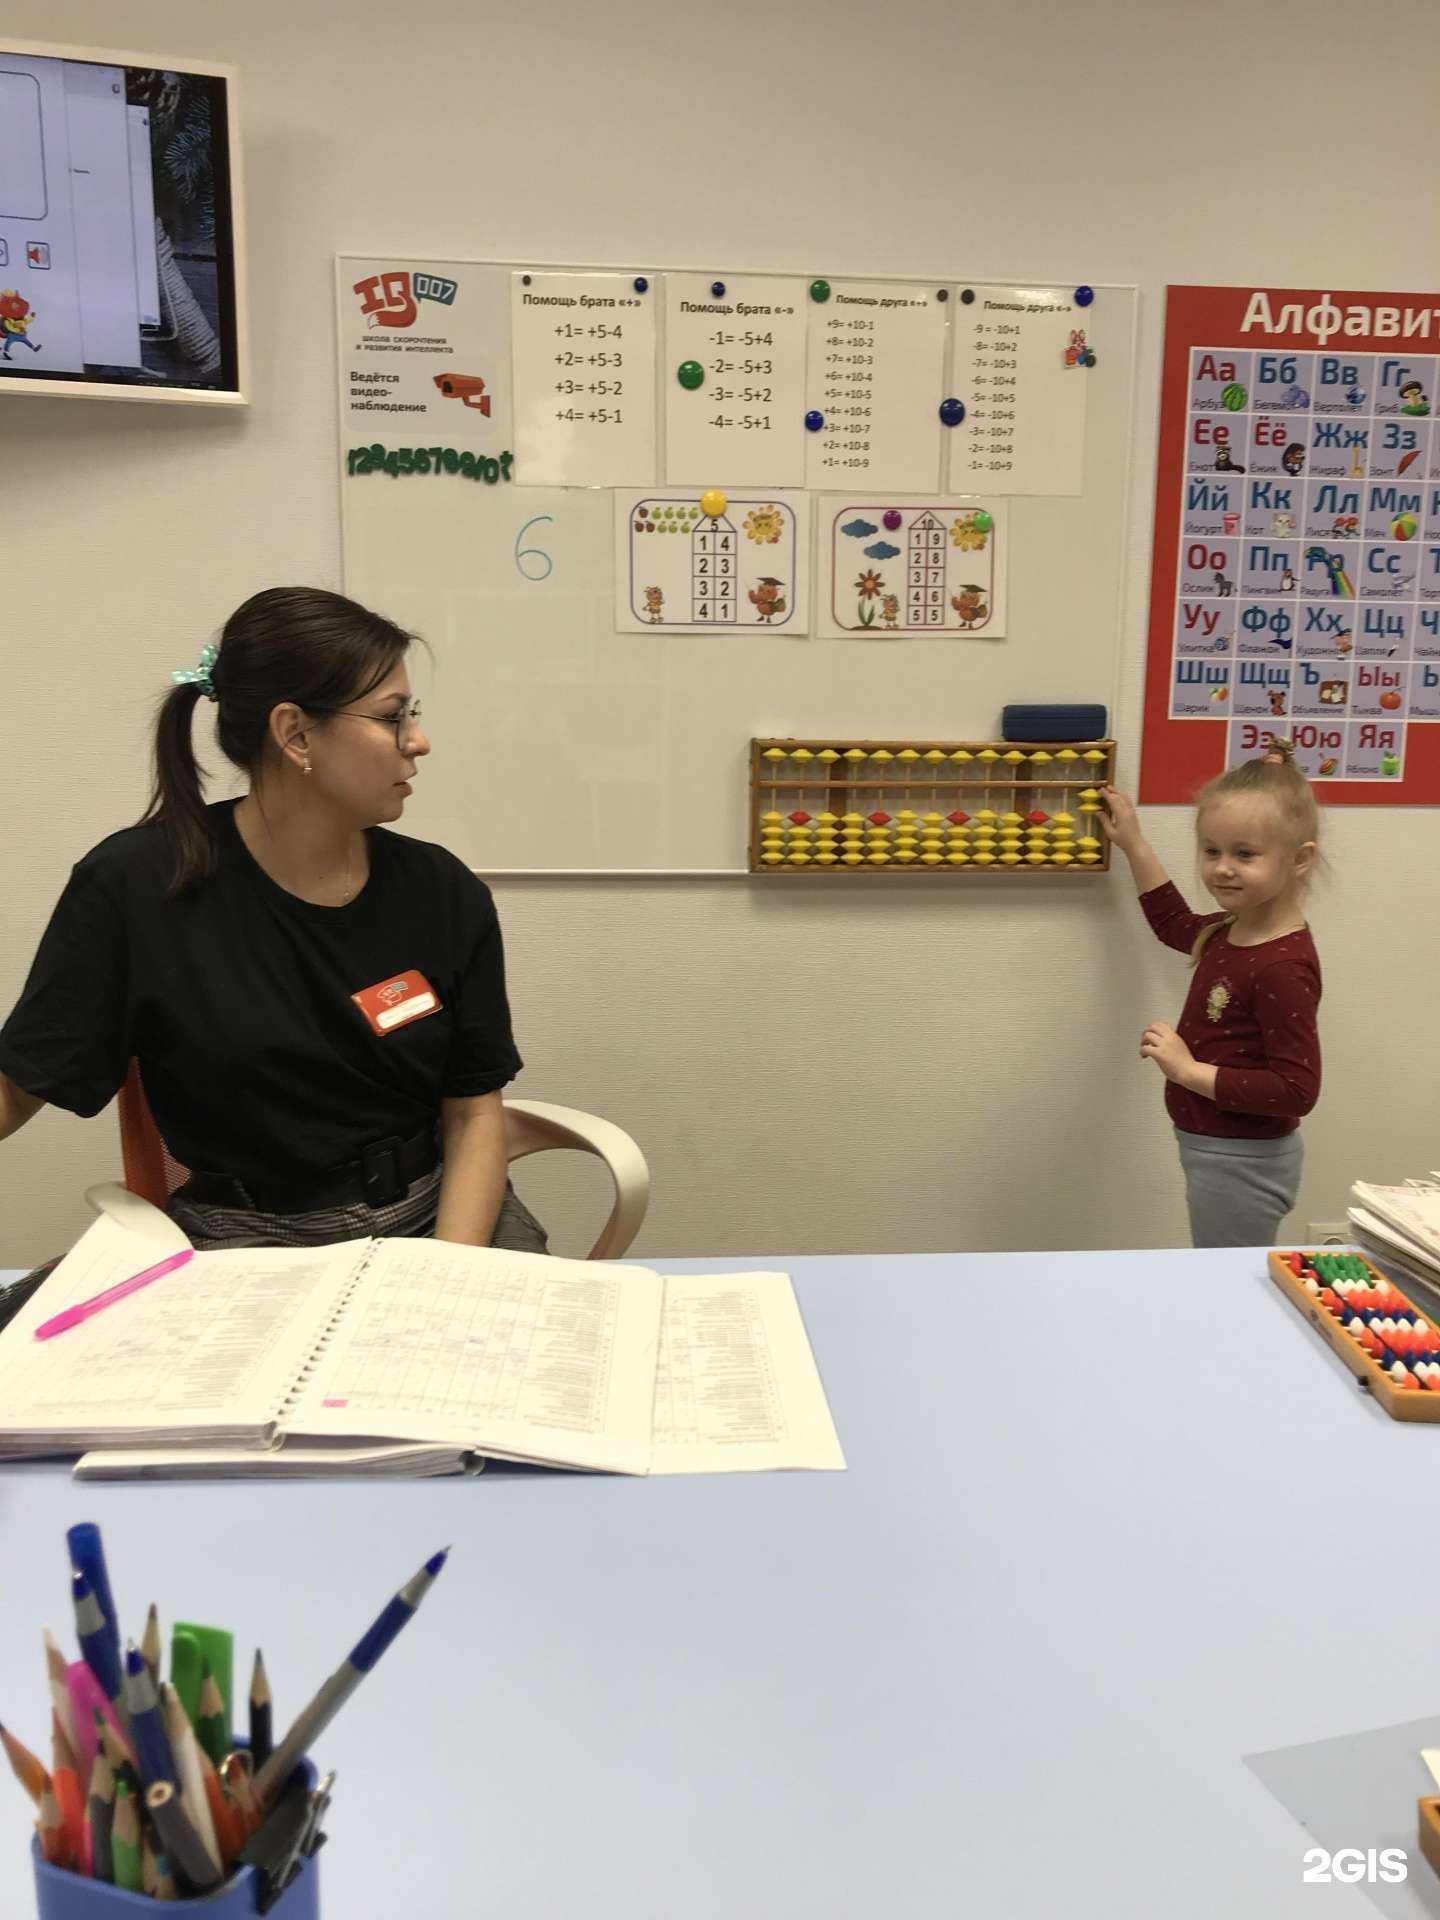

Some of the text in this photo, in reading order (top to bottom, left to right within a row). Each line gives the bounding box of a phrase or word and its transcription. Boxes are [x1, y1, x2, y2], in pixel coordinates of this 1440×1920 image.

[417, 277, 454, 299] 007
[523, 294, 577, 307] Помощь
[580, 295, 615, 308] брата
[680, 301, 734, 315] Помощь
[736, 303, 771, 316] брата
[836, 295, 879, 307] Помощь
[879, 298, 908, 308] друга
[984, 301, 1025, 312] Помощь
[1026, 303, 1054, 313] друга
[554, 324, 622, 338] +1= +5-4
[709, 331, 773, 346] -1= -5+4
[554, 352, 622, 367] +2= +5-3
[709, 359, 772, 374] -2= -5+3
[1196, 355, 1235, 381] Аа
[1259, 357, 1297, 384] Бб
[1320, 358, 1358, 385] Вв
[1382, 361, 1410, 387] Гг
[350, 371, 400, 383] Ведётся
[350, 387, 392, 397] видео-
[555, 380, 622, 395] +3= +5-2
[709, 387, 772, 402] -3= -5+2
[350, 401, 427, 412] наблюдение
[556, 408, 623, 423] +4= +5-1
[709, 415, 771, 430] -4= -5+1
[1194, 419, 1229, 445] Ее
[1255, 416, 1287, 446] Ёё
[1312, 422, 1368, 448] Жж
[1382, 423, 1416, 449] Зз
[1188, 478, 1228, 511] Йй
[1252, 481, 1292, 509] Кк
[1313, 485, 1360, 513] Лл
[1369, 487, 1421, 512] Мм
[710, 518, 719, 532] 5
[699, 535, 707, 551] 1
[720, 536, 730, 551] 4
[914, 533, 921, 545] 1
[932, 533, 940, 545] 9
[514, 516, 554, 582] 6
[914, 552, 921, 564] 2
[932, 552, 940, 564] 8
[1188, 544, 1227, 570] Оо
[1249, 546, 1289, 571] Пп
[1368, 548, 1401, 573] Сс
[699, 558, 708, 573] 2
[721, 558, 730, 574] 3
[914, 571, 921, 583] 3
[932, 571, 939, 583] 7
[699, 580, 708, 596] 3
[720, 581, 730, 596] 2
[913, 590, 920, 602] 4
[931, 590, 939, 602] 6
[699, 603, 708, 618] 4
[721, 603, 728, 618] 1
[913, 609, 920, 621] 5
[931, 609, 938, 621] 5
[1184, 604, 1221, 636] Уу
[1242, 606, 1290, 638] Фф
[1304, 607, 1343, 632] Хх
[1364, 609, 1404, 638] Цц
[1177, 661, 1228, 683] Шш
[1240, 662, 1290, 688] Щщ
[1300, 663, 1320, 685] Ъ
[1358, 666, 1400, 687] Ыы
[1292, 725, 1342, 749] Юю
[1359, 724, 1395, 749] Яя
